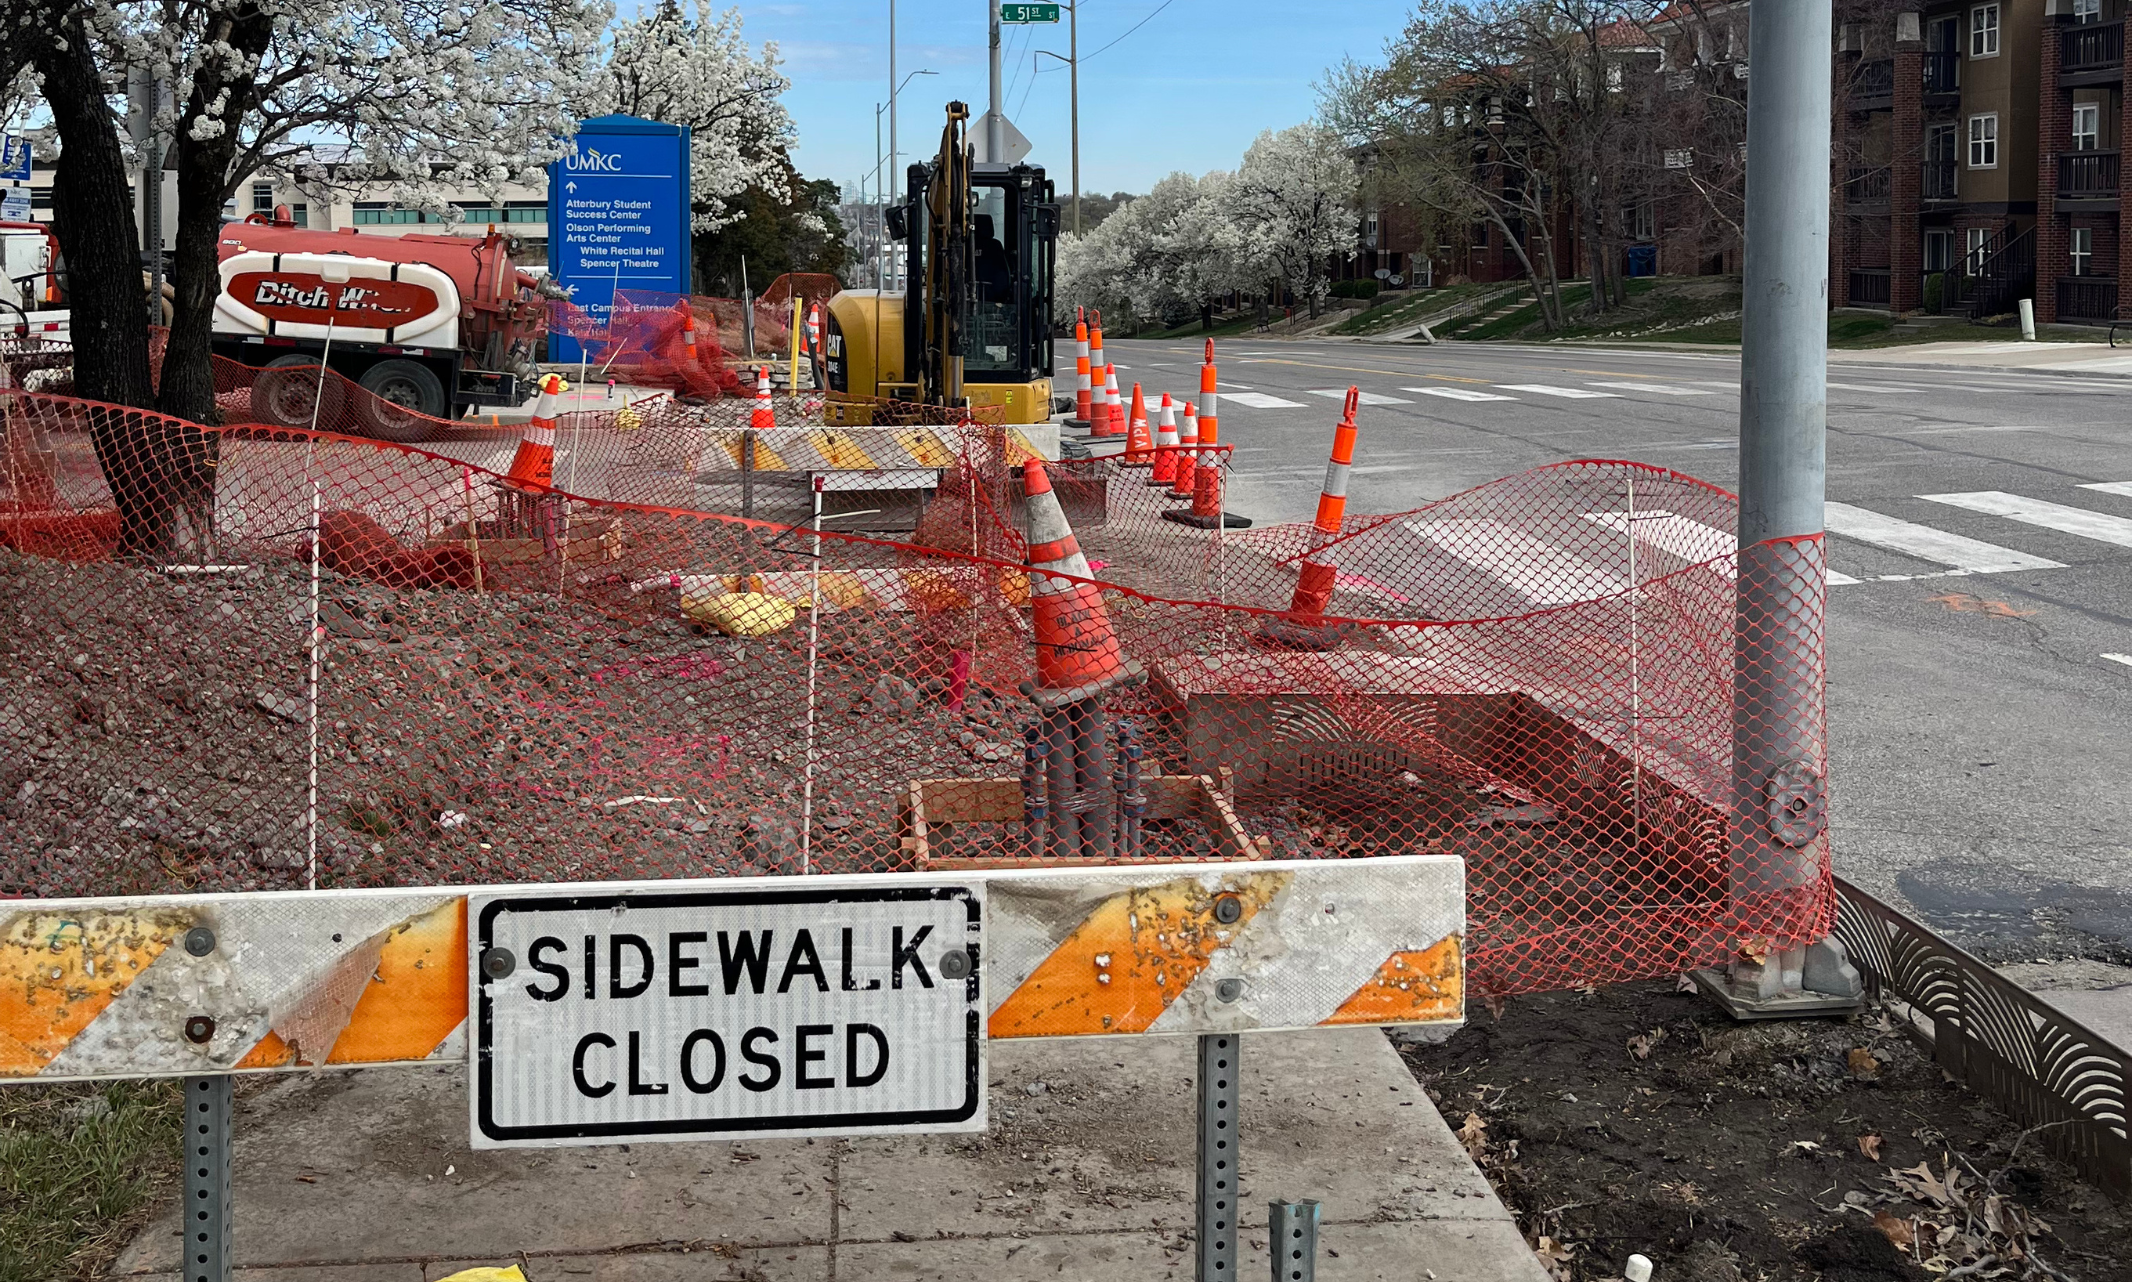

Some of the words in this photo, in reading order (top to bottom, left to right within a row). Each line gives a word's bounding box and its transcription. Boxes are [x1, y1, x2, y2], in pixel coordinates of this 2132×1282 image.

[1048, 11, 1055, 19] ST
[566, 154, 621, 171] UMKC
[566, 200, 611, 209] Atterbury
[614, 200, 651, 209] Student
[566, 211, 607, 219] Success
[610, 211, 641, 219] Center
[566, 224, 595, 232] Olson
[598, 224, 651, 234] Performing
[567, 234, 586, 242] Arts
[589, 234, 621, 243] Center
[581, 247, 607, 255] White
[611, 247, 643, 255] Recital
[646, 247, 664, 255] Hall
[580, 259, 621, 269] Spencer
[256, 281, 330, 308] Ditch
[568, 304, 588, 312] ast
[591, 304, 631, 314] Campus
[828, 334, 842, 357] CAT
[525, 924, 935, 1002] SIDEWALK
[572, 1023, 890, 1099] CLOSED
